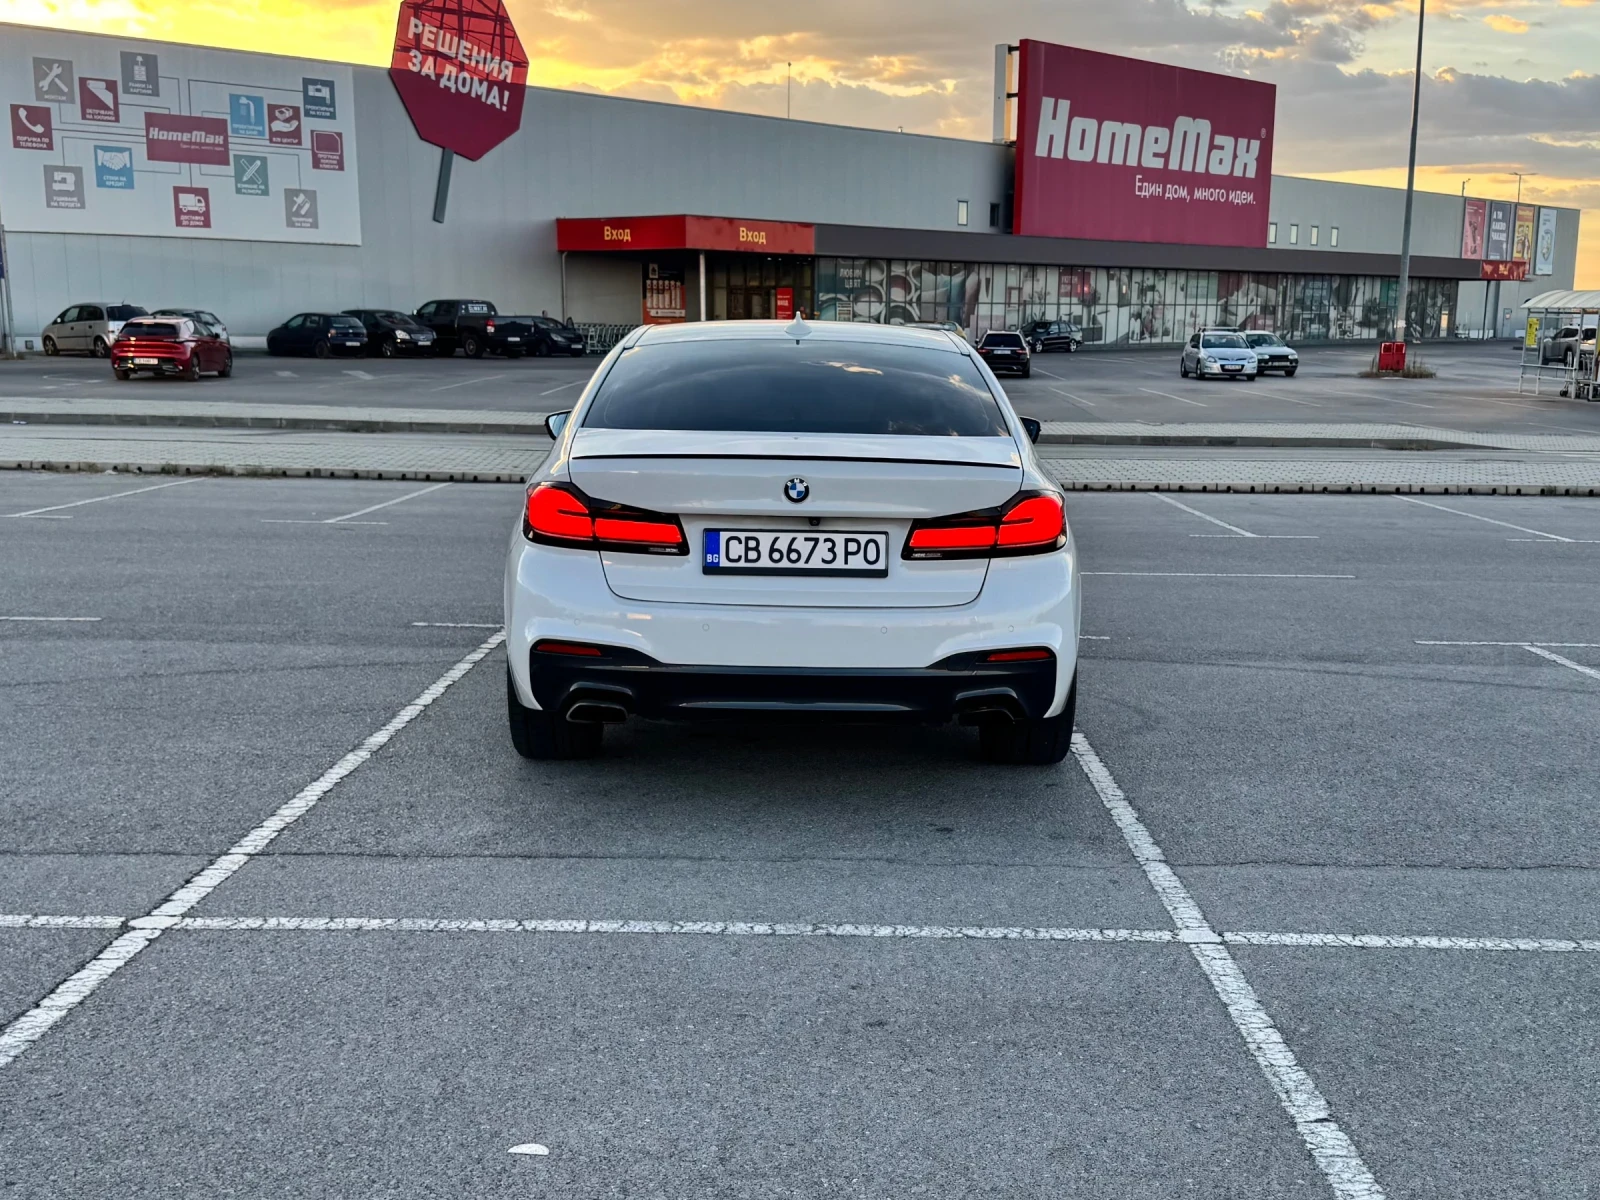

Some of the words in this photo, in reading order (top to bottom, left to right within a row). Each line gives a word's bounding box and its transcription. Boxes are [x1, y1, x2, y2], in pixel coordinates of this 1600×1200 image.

[408, 17, 513, 83] РЕШЕНИЯ
[408, 49, 435, 80] ЗА
[440, 63, 510, 111] ДОМА!
[149, 127, 224, 144] HomeMax
[1035, 96, 1260, 178] HomeMax
[1135, 175, 1162, 198] Един
[1165, 184, 1190, 203] дом,
[1194, 186, 1226, 202] много
[1229, 189, 1256, 206] идеи.
[604, 226, 631, 242] Вход
[739, 227, 766, 244] Вход
[706, 554, 719, 563] BG
[724, 535, 761, 564] CB
[768, 536, 837, 565] 6673
[844, 537, 880, 565] PO
